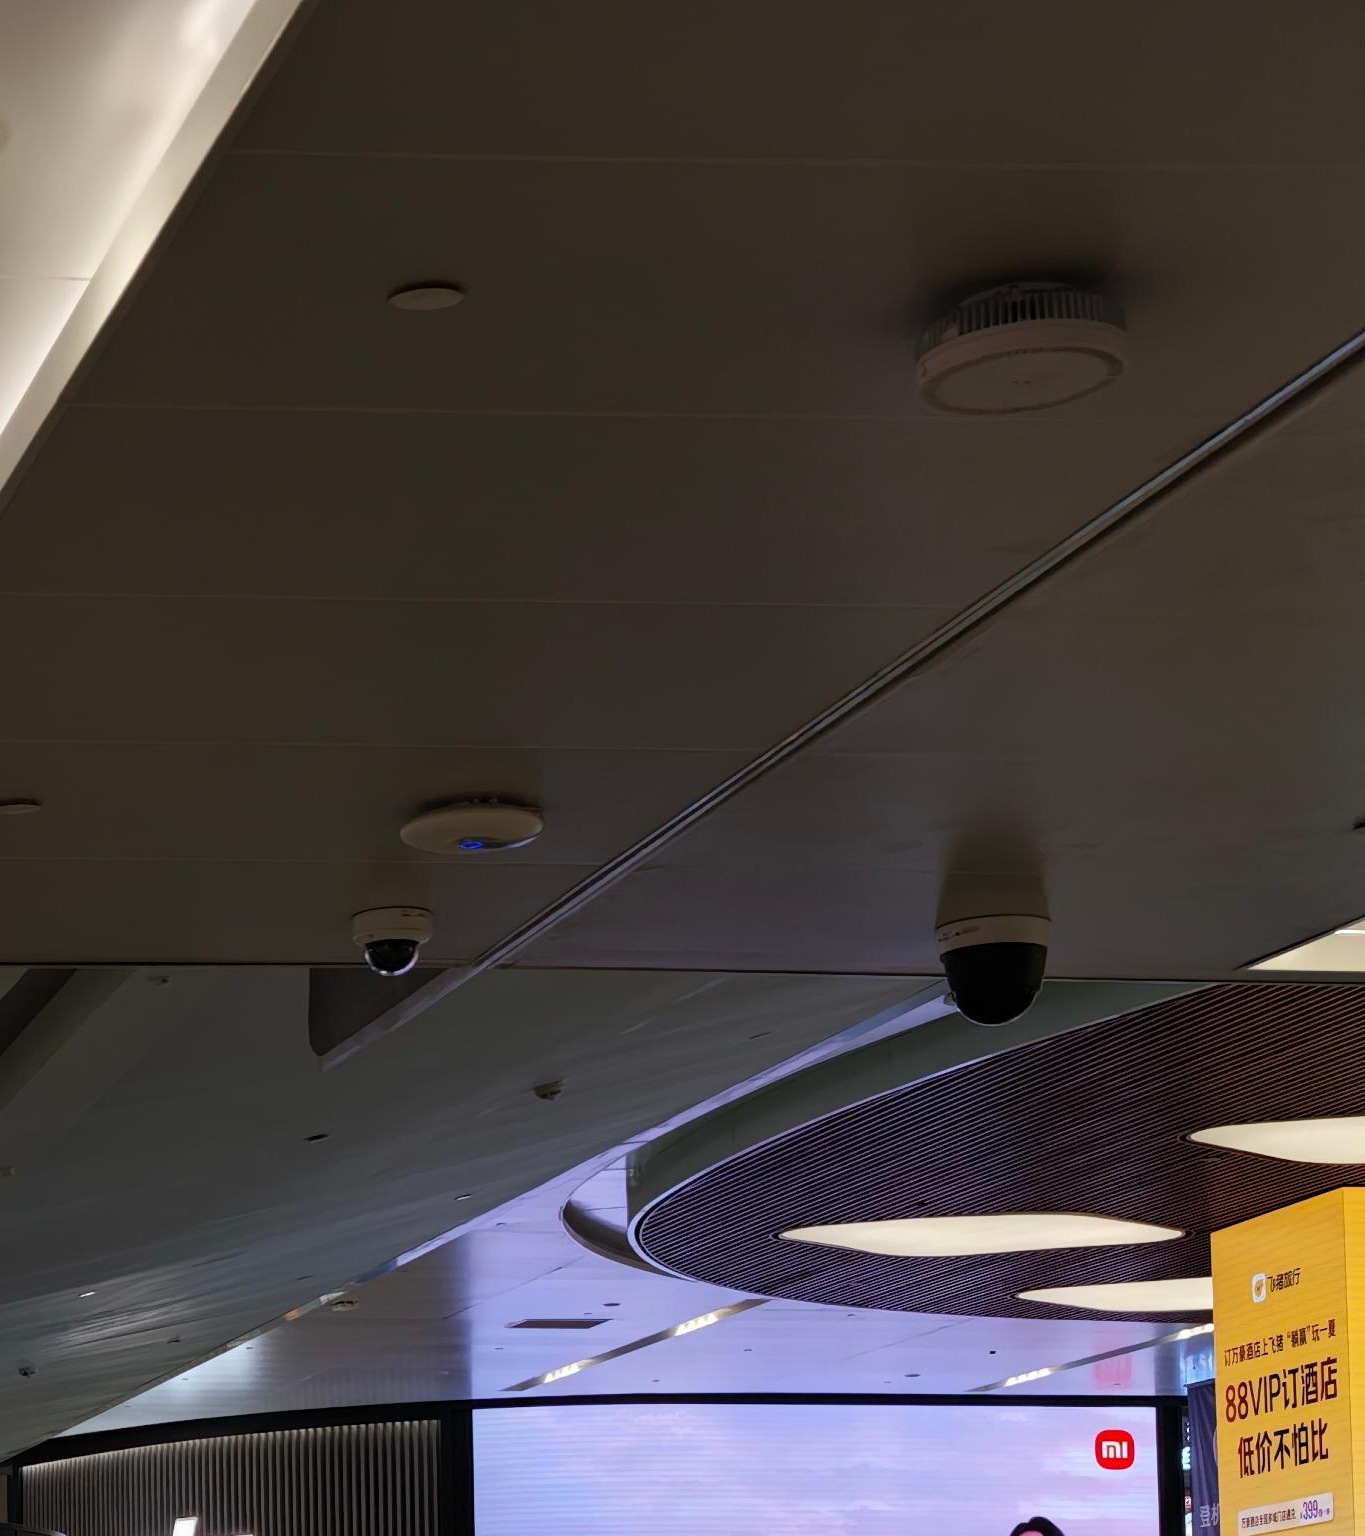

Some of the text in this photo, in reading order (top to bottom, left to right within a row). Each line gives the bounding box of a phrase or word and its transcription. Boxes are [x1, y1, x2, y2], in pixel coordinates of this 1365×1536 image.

[1237, 1417, 1329, 1478] 低价不怕比
